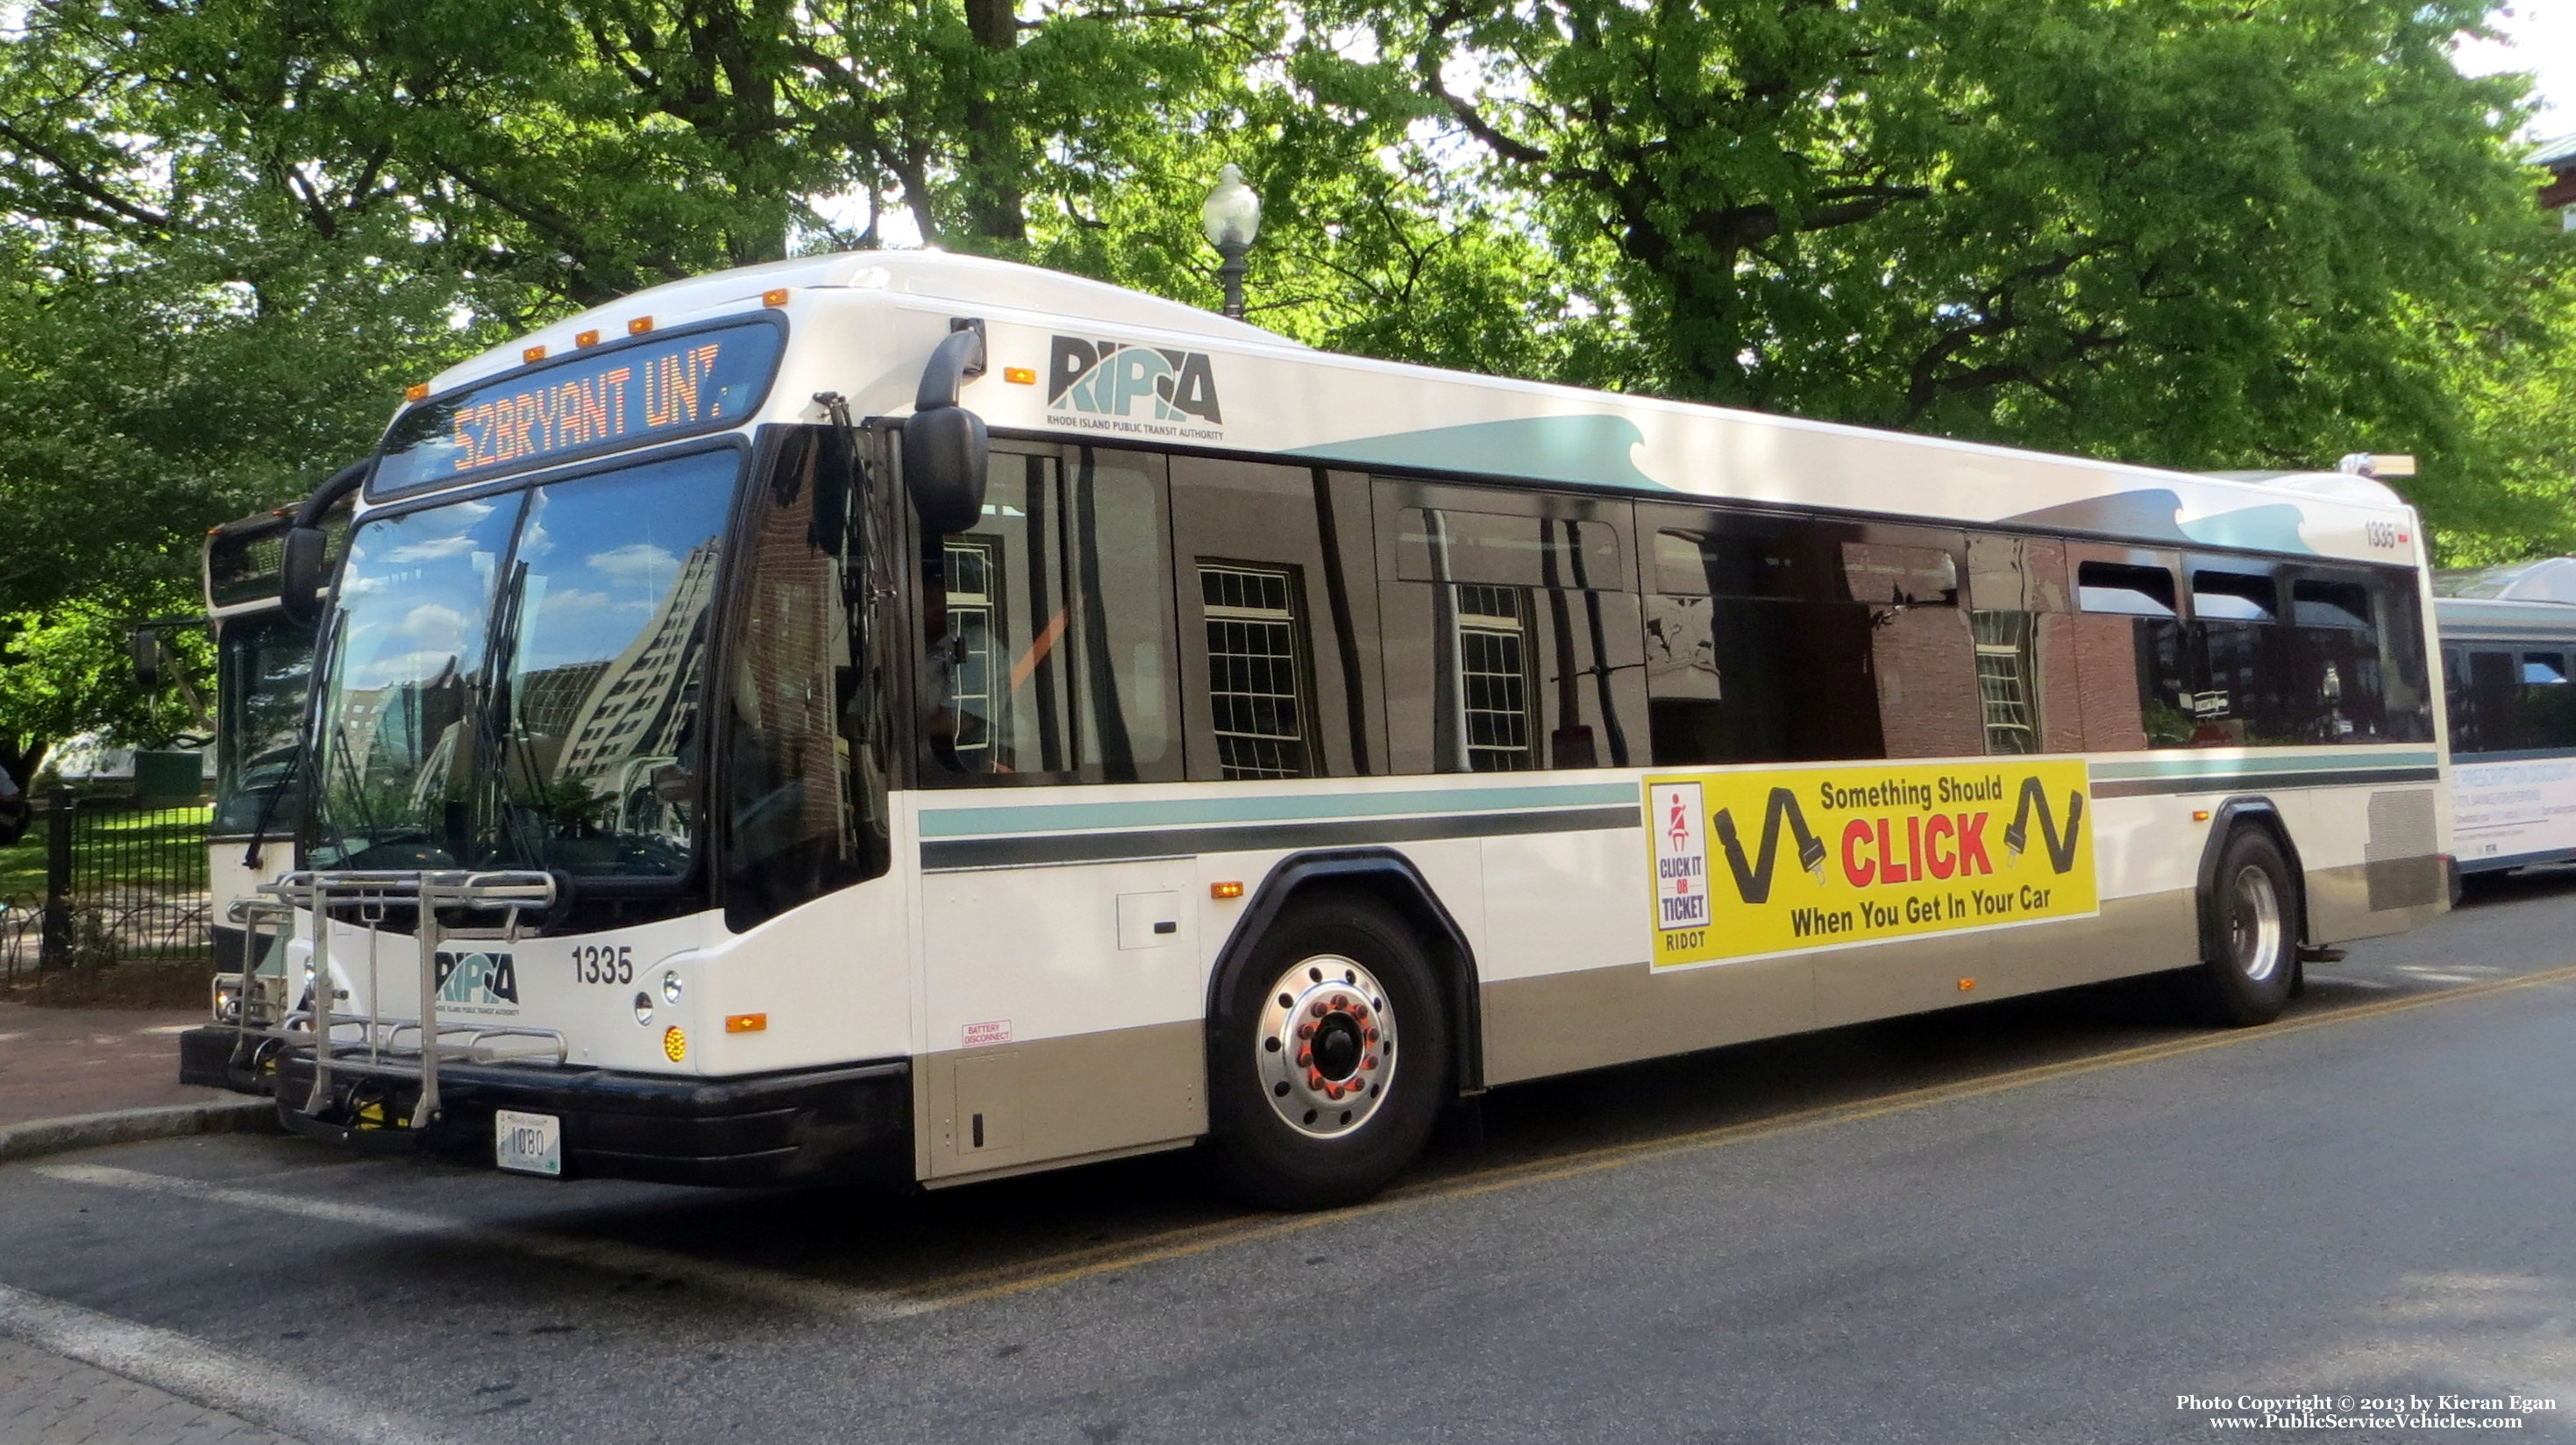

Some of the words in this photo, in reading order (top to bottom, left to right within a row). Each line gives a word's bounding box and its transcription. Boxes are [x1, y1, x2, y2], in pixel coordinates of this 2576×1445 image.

[1048, 335, 1223, 425] RIPTA
[1047, 415, 1078, 427] RHODE
[1079, 417, 1110, 430] ISLAND
[1113, 422, 1142, 433] PUBLIC
[1143, 424, 1177, 437] TRANSIT
[1178, 428, 1223, 441] AUTHORITY
[2366, 520, 2395, 548] 1335
[1821, 779, 1932, 810] Something
[1939, 774, 2003, 804] Should
[1841, 811, 1994, 888] CLICK
[1660, 857, 1691, 879] CLICK
[1692, 856, 1702, 876] IT
[1676, 879, 1688, 894] OR
[1662, 894, 1704, 922] TICKET
[1790, 906, 1854, 937] When
[1860, 900, 1899, 928] You
[1905, 894, 1941, 922] Get
[1947, 893, 1966, 918] In
[1971, 887, 2015, 915] Your
[2020, 884, 2052, 911] Car
[1666, 931, 1705, 951] RIDOT
[572, 945, 633, 985] 1335
[964, 1031, 1009, 1043] DISCONNECT
[968, 1024, 1000, 1035] BATTERY
[512, 1127, 544, 1156] 1080
